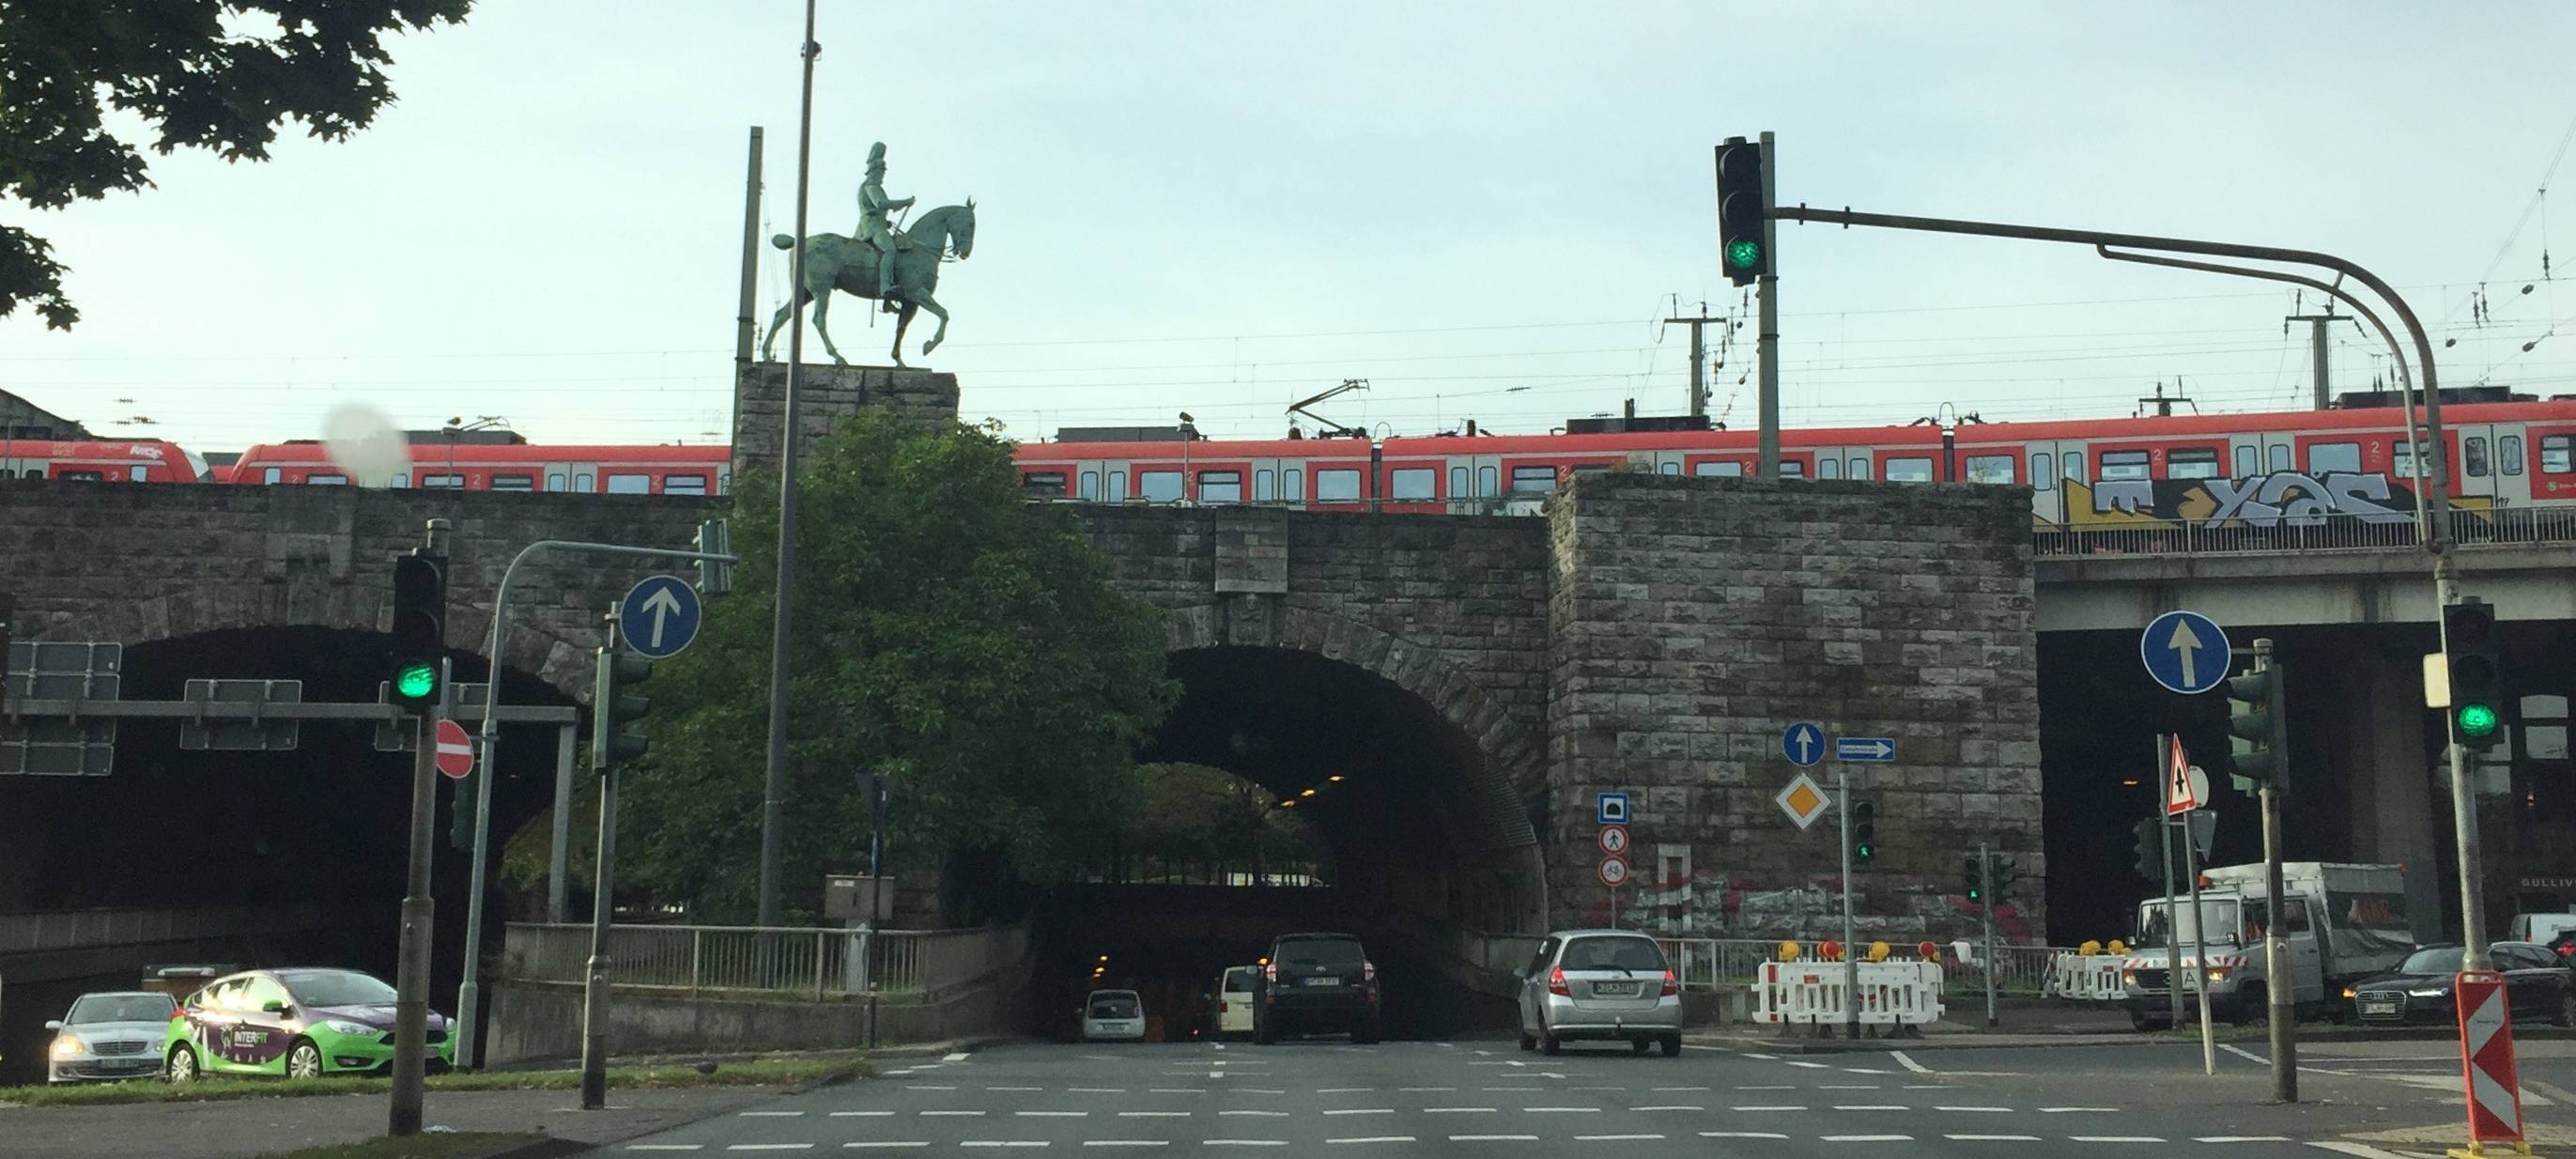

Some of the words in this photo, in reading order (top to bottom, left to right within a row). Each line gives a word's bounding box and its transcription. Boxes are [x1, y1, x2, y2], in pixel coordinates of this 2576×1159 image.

[2372, 441, 2380, 453] 2
[2153, 449, 2162, 460] 2
[1559, 465, 1567, 476] 2
[1745, 461, 1752, 472] 2
[2521, 878, 2576, 888] GULLIV
[2183, 970, 2198, 985] A
[234, 1030, 269, 1043] INTERFIT
